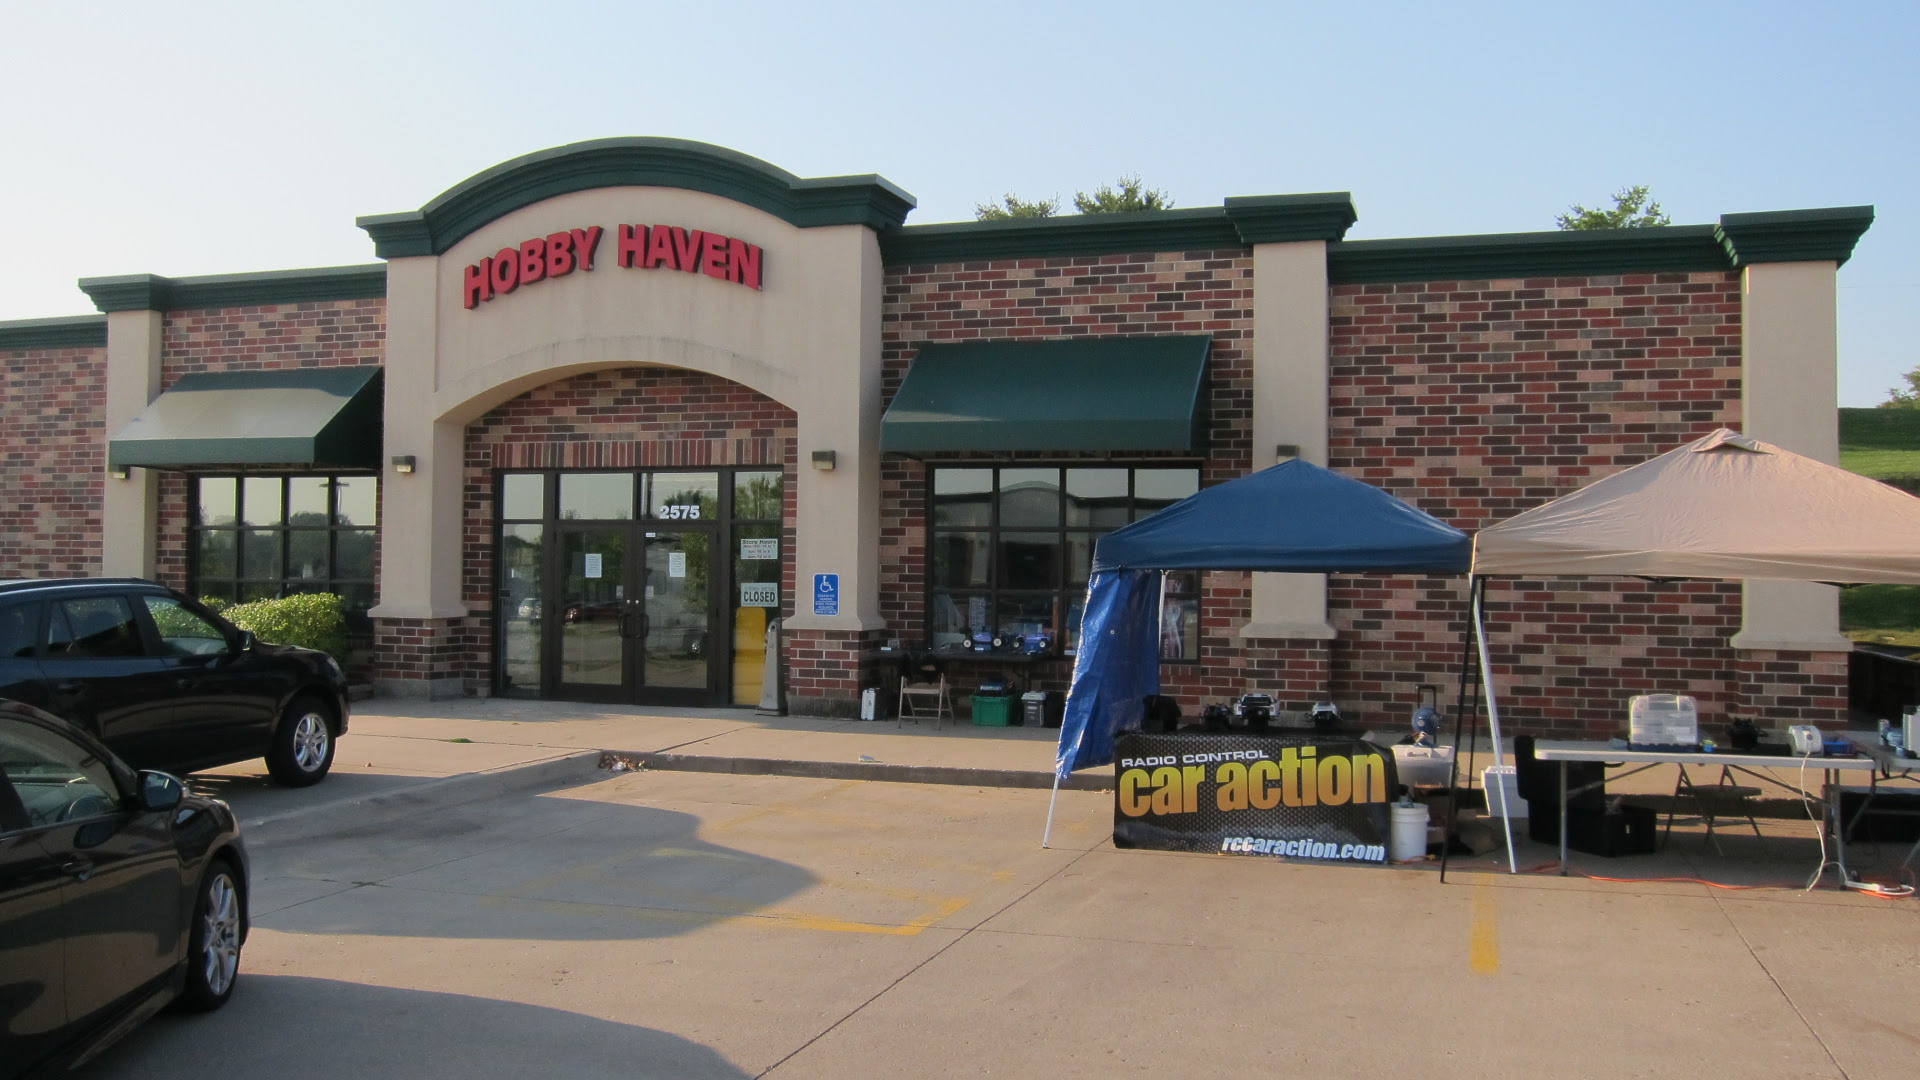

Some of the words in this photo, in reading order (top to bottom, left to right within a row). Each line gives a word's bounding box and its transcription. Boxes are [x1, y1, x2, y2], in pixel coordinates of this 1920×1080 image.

[464, 226, 604, 310] HOBBY
[617, 224, 763, 291] HAVEN
[659, 504, 700, 520] 2575
[743, 591, 776, 603] CLOSED
[1121, 755, 1177, 768] RADIO
[1182, 749, 1269, 764] CONTROL
[1119, 764, 1206, 818] car
[1216, 746, 1386, 812] action
[1221, 836, 1386, 862] rccaraction.com
